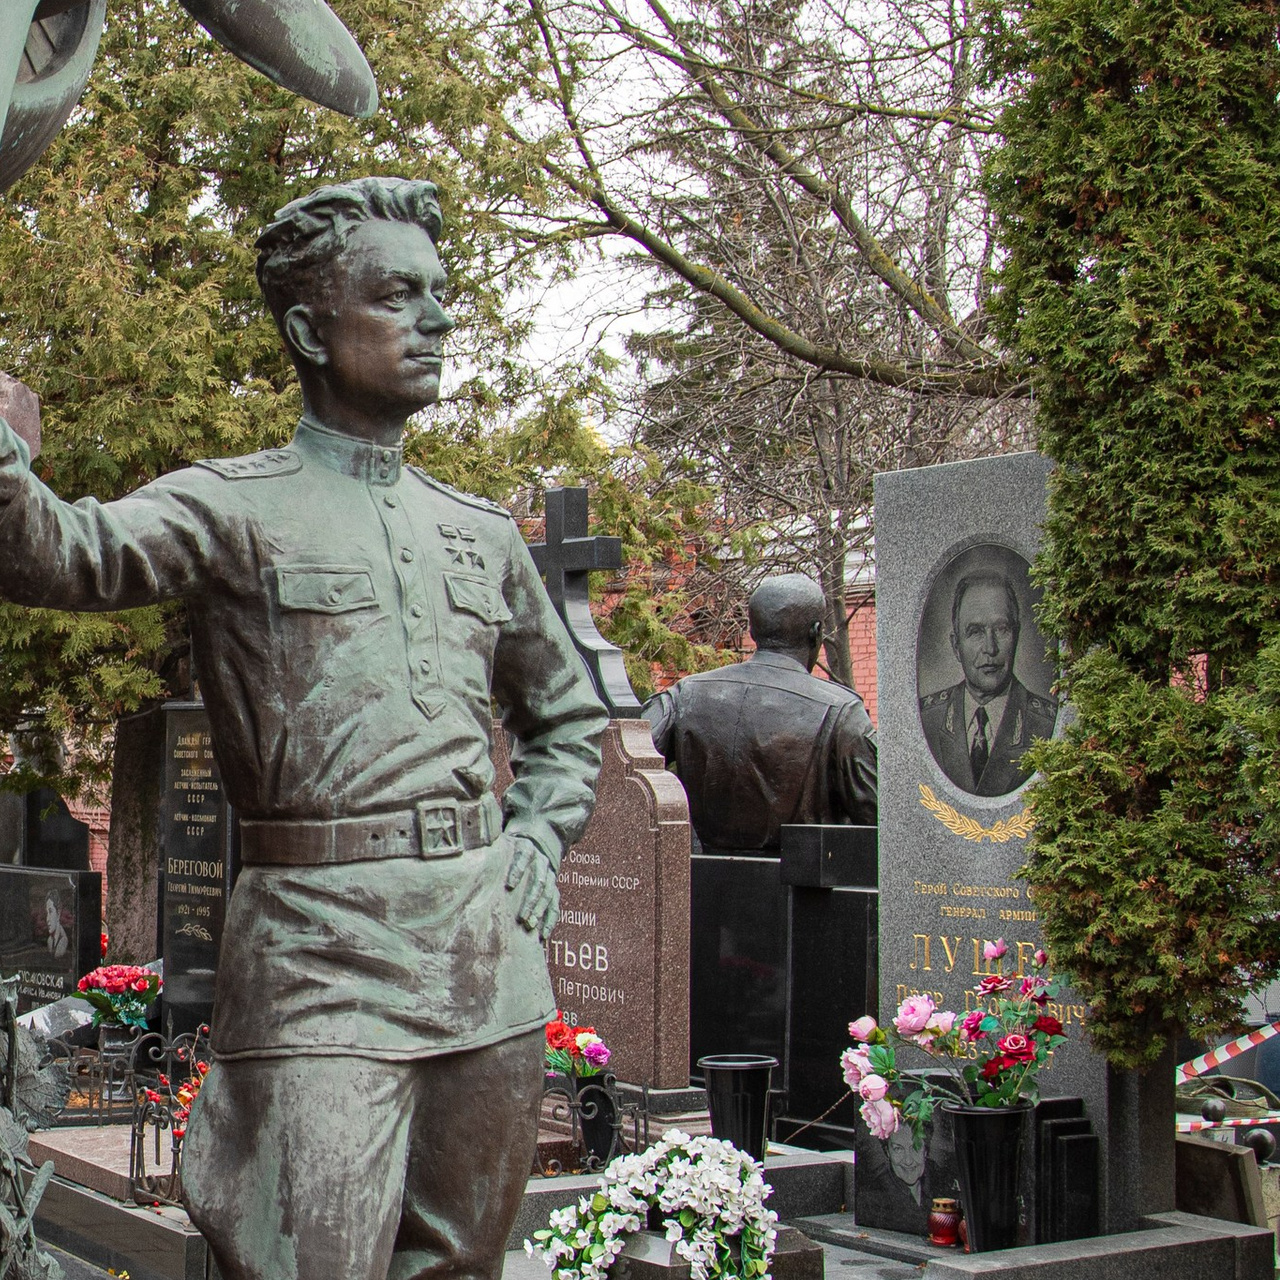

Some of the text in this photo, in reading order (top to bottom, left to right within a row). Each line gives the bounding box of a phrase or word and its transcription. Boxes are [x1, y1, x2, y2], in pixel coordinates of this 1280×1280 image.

[569, 850, 601, 865] Союза
[167, 857, 223, 879] БЕРЕГОВОЙ
[572, 871, 609, 888] Премии
[940, 906, 986, 919] ГЕНЕРАЛ
[558, 977, 624, 1004] Петрович
